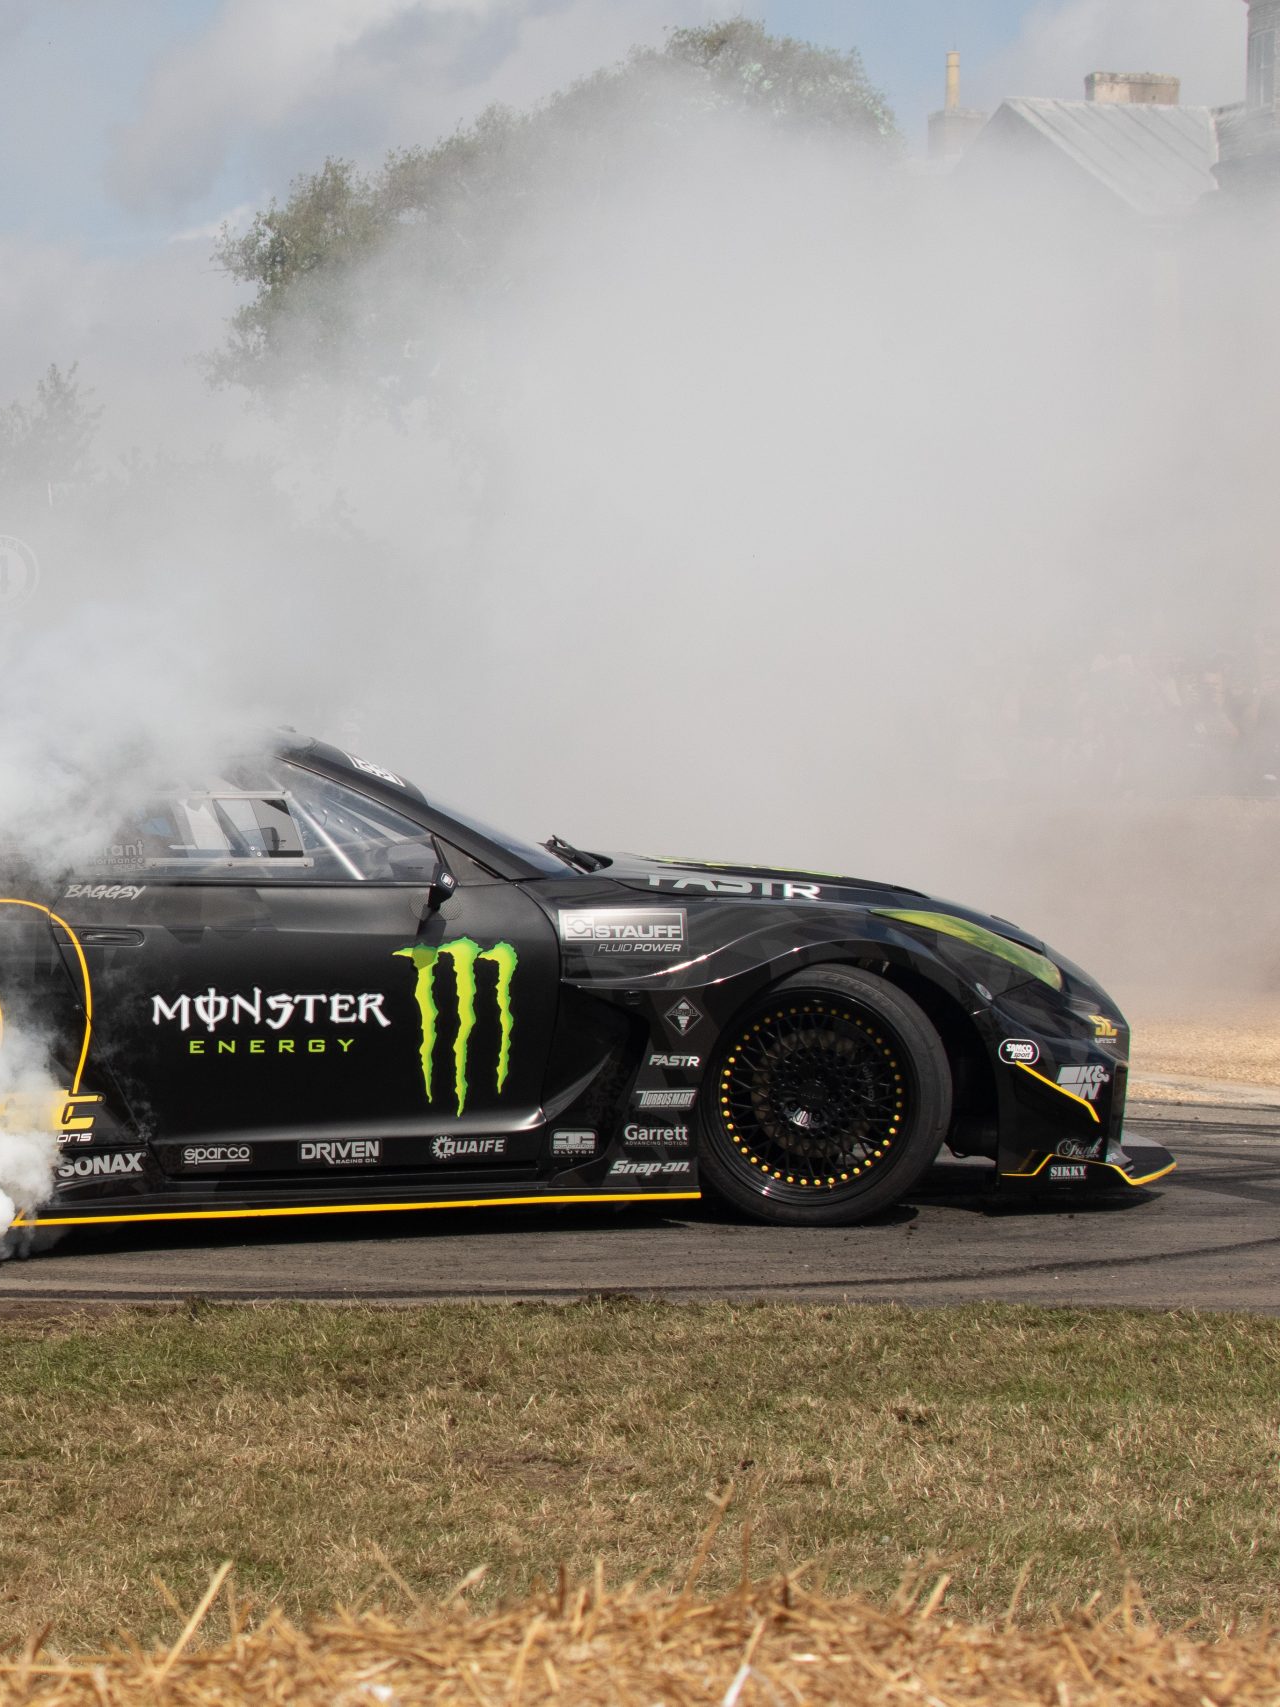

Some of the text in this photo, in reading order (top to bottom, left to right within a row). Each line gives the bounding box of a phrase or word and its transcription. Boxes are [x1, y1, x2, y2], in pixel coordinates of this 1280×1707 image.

[64, 884, 147, 901] BAGGSY
[594, 924, 682, 938] STAUFF
[597, 943, 682, 952] FLUID POWER
[188, 1038, 355, 1054] ENERGY
[648, 1054, 700, 1068] FASTR
[636, 1089, 697, 1106] TURBOSMART
[624, 1125, 688, 1141] Garrett
[301, 1140, 380, 1165] DRIVEN
[444, 1139, 506, 1154] QUAIFE
[183, 1146, 251, 1165] sparco
[1049, 1165, 1087, 1177] SIKKY
